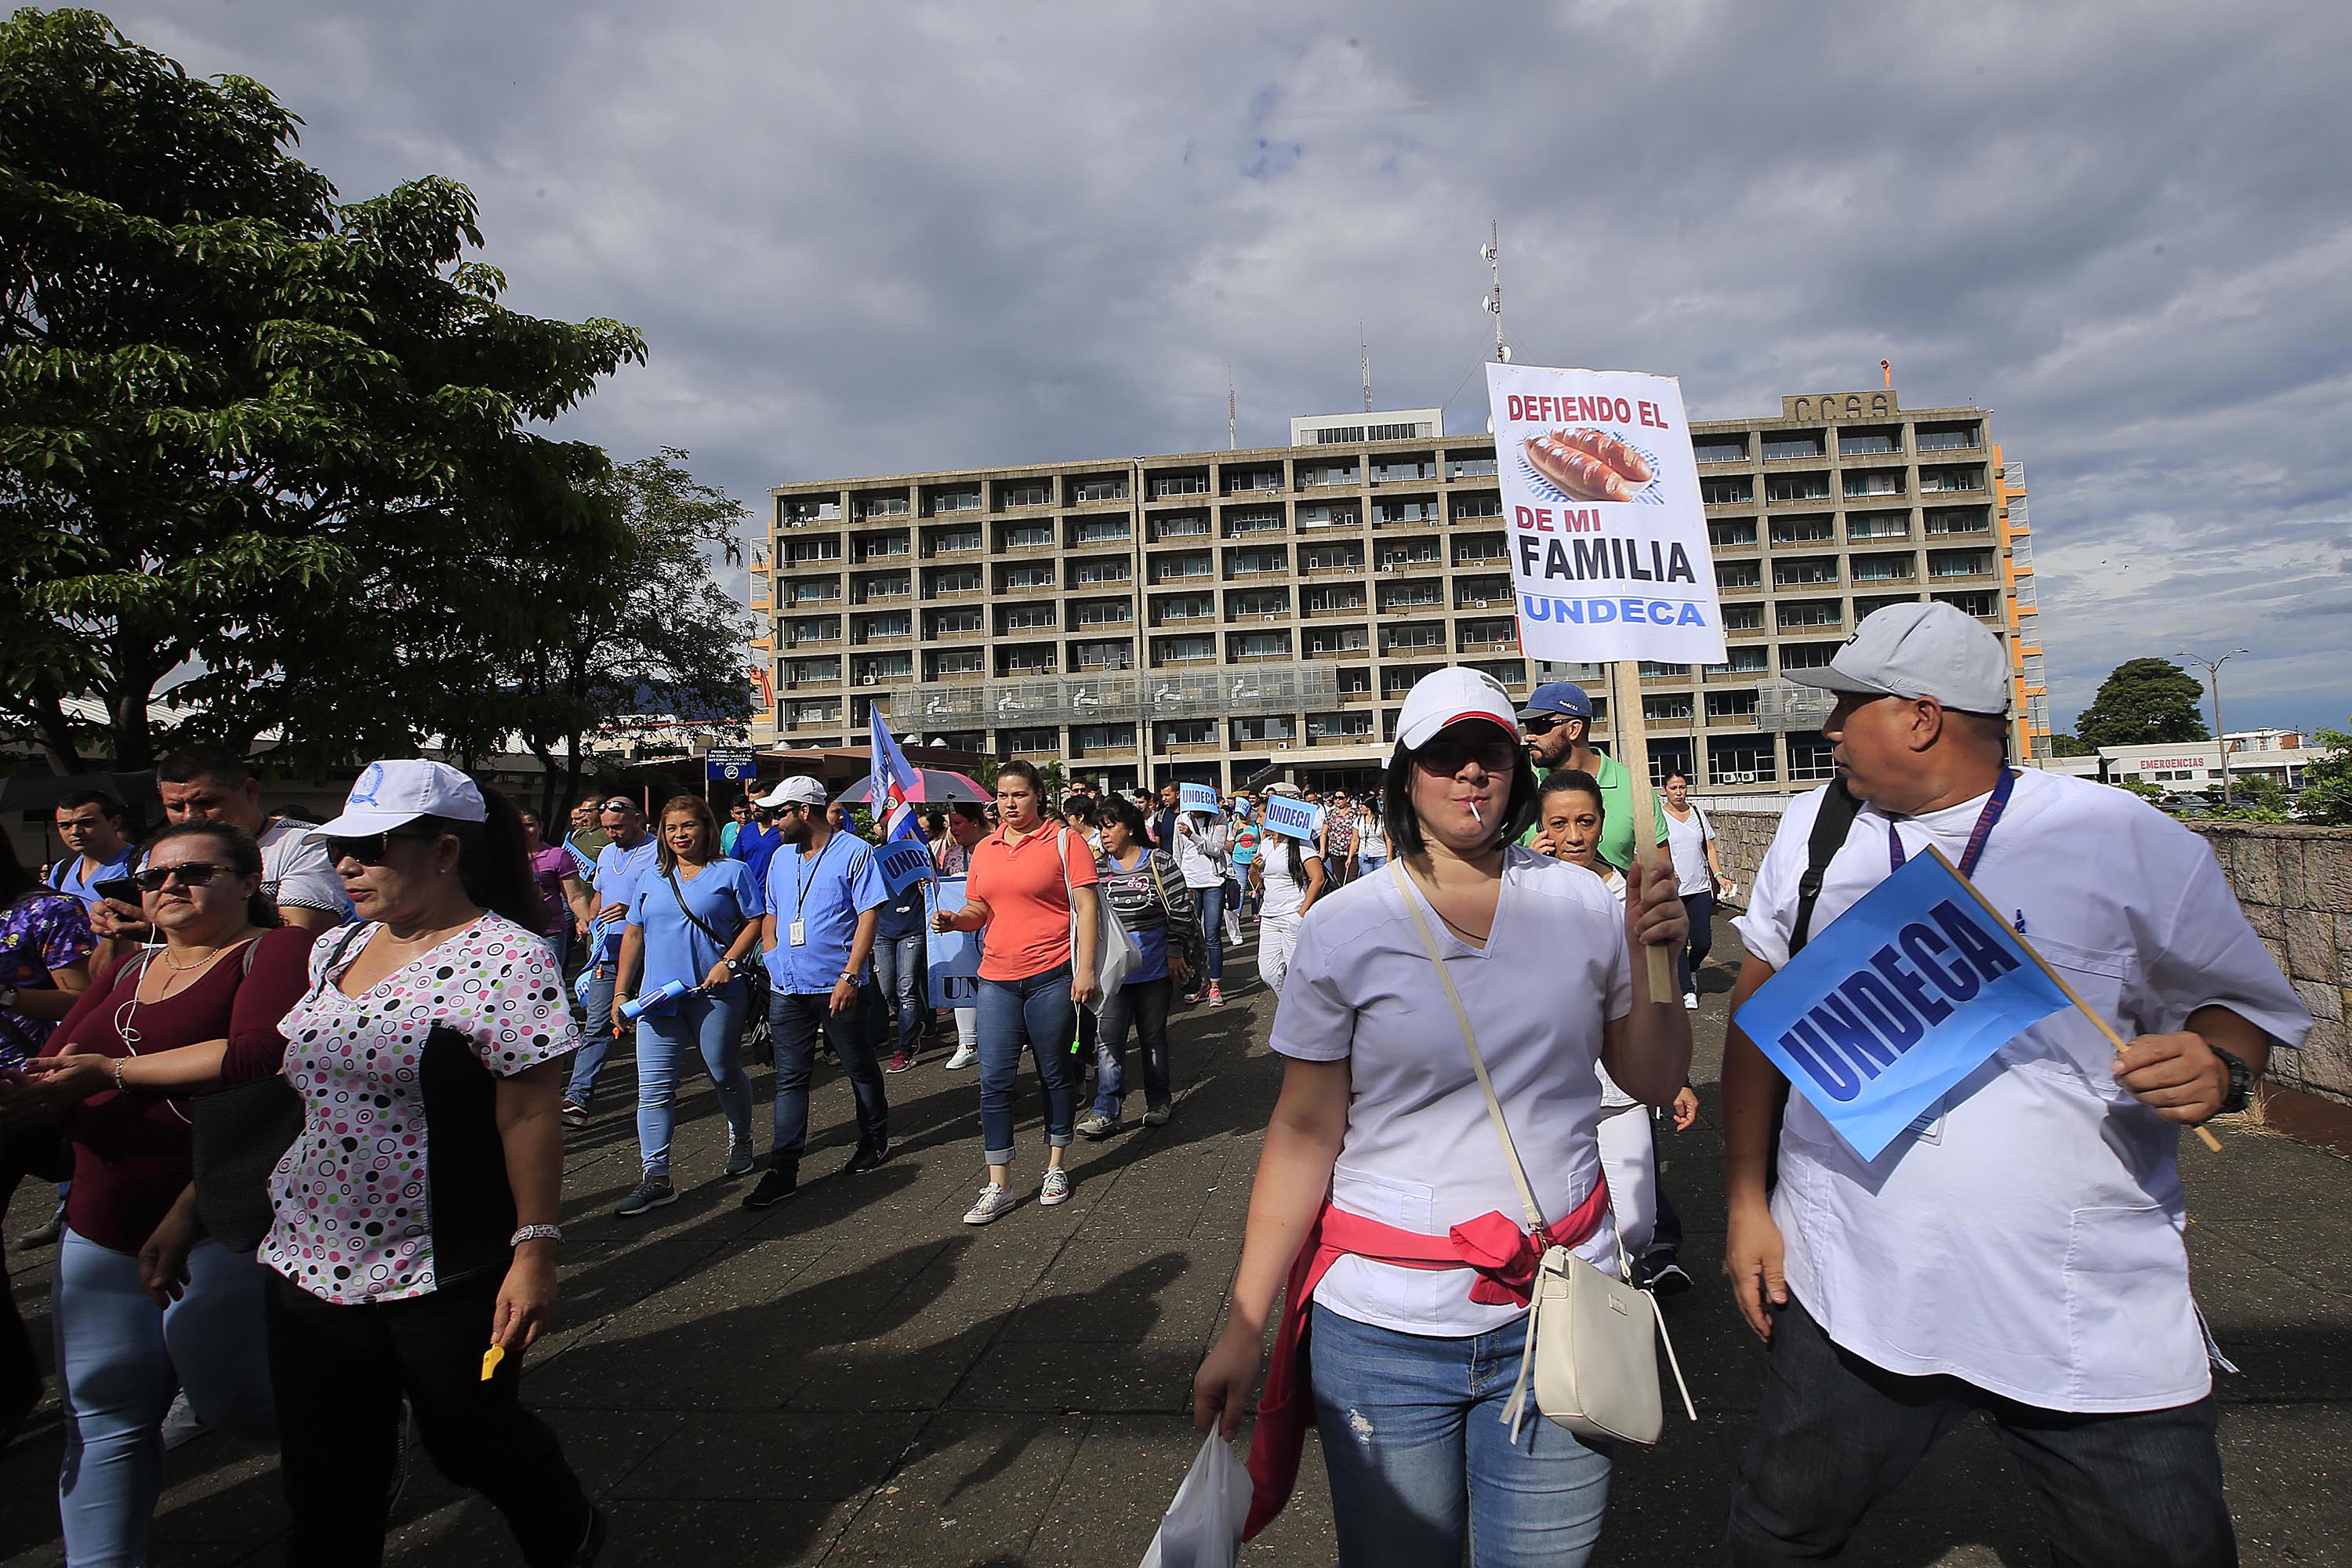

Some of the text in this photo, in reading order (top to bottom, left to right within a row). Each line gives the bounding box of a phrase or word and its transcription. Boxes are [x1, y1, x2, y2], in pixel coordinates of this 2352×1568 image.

[1508, 394, 1669, 430] DEFIENDO EL
[1795, 393, 1888, 422] CCSS
[1515, 506, 1601, 532] DE MI
[1518, 535, 1697, 584] FAMILIA
[1523, 596, 1707, 627] UNDECA
[2140, 757, 2205, 770] EMERGENCIAS
[1182, 788, 1217, 807] UNDECA
[1268, 803, 1312, 830] UNDECA
[1777, 899, 2021, 1102] UNDECA
